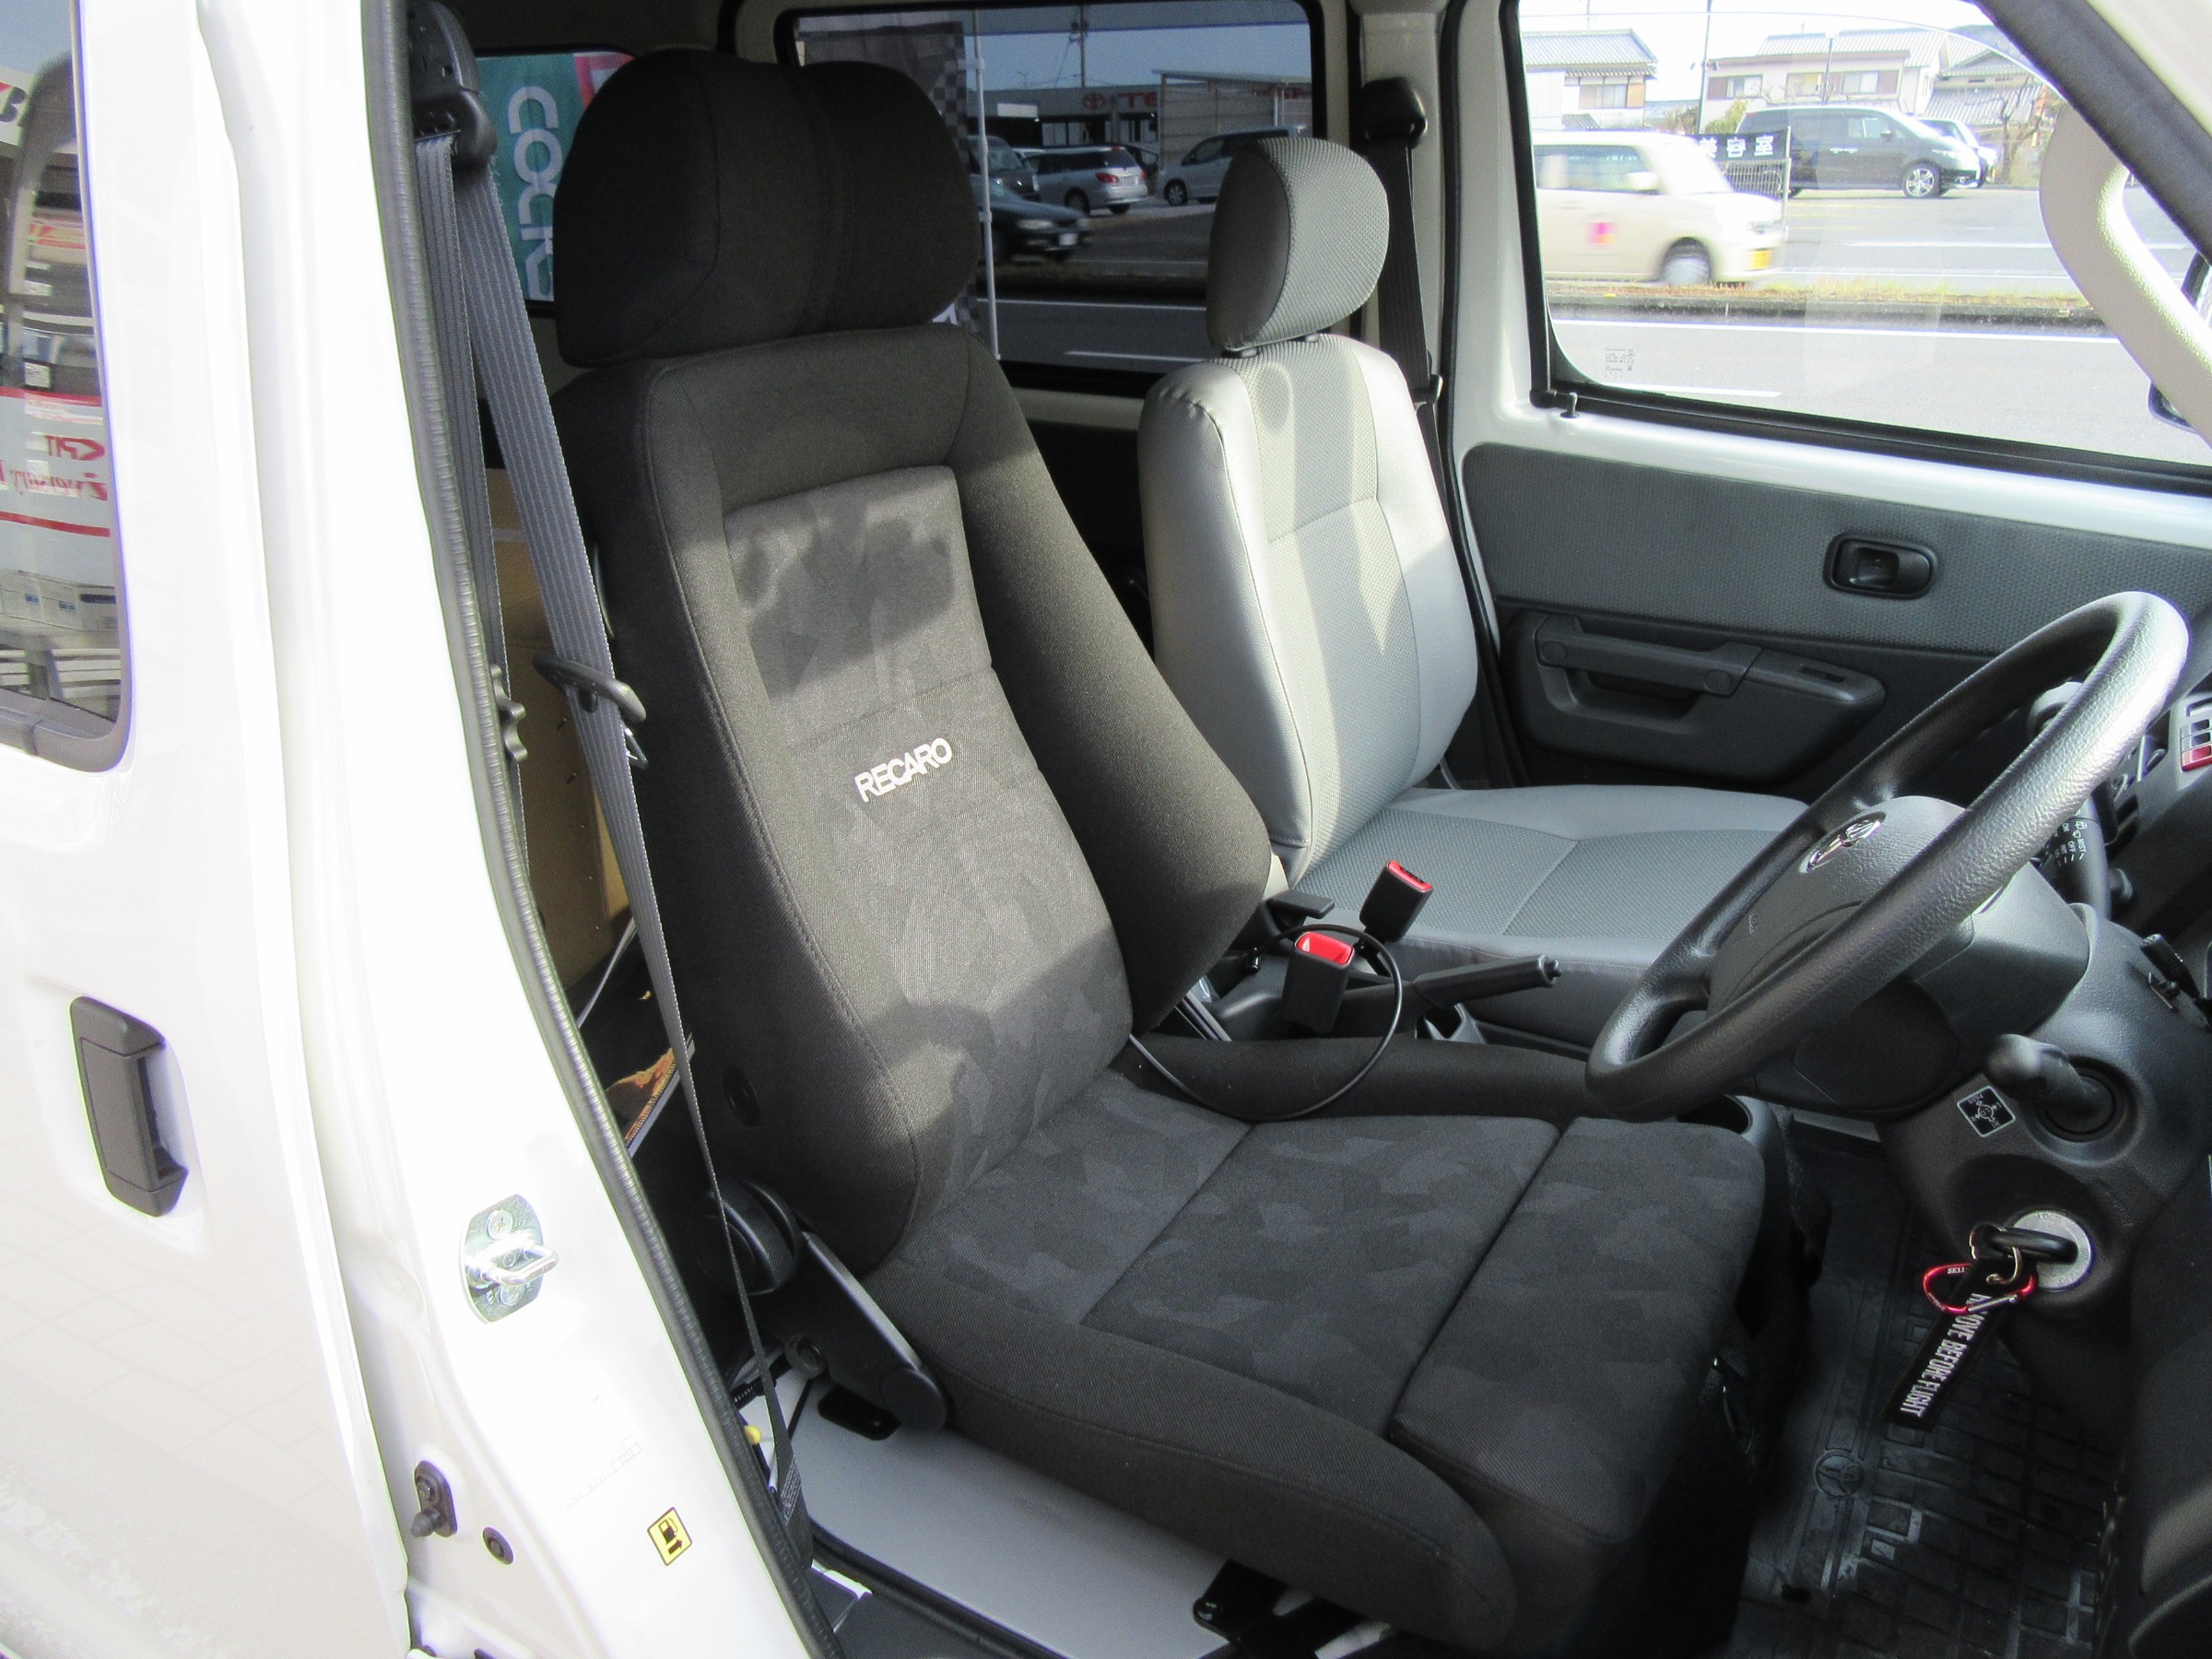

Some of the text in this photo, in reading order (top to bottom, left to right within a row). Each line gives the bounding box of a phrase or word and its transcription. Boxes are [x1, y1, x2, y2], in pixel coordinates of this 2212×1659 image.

[1700, 135, 1774, 159] 美容室
[854, 737, 953, 803] RECARO
[1921, 1338, 1968, 1382] BEFORE
[1900, 1379, 1941, 1418] FLIGHT
